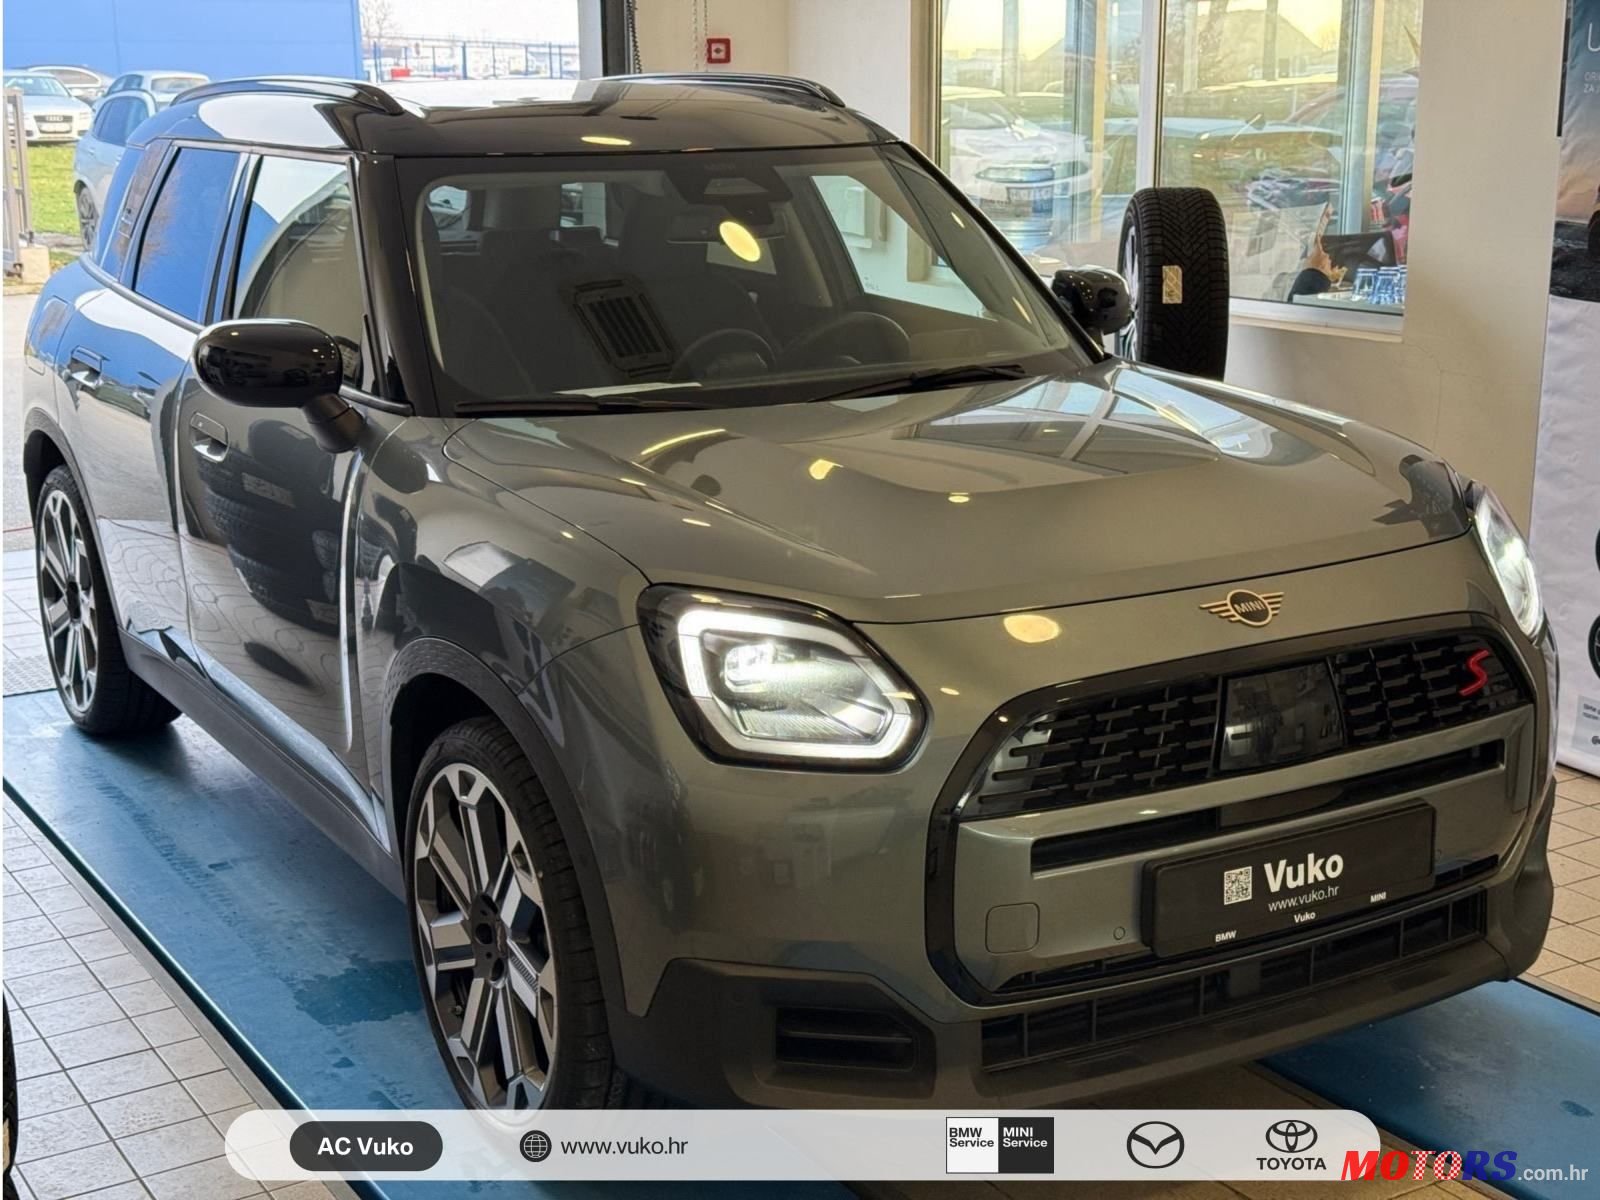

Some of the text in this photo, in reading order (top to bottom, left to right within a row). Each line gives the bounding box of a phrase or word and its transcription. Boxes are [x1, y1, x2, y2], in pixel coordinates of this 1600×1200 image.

[1236, 600, 1265, 615] MINI
[1458, 649, 1489, 696] S
[1264, 853, 1344, 893] Vuko
[1268, 885, 1339, 912] www.vuko.hr
[1370, 891, 1387, 903] MINI
[1294, 911, 1316, 923] Vuko
[1215, 930, 1237, 942] BMW
